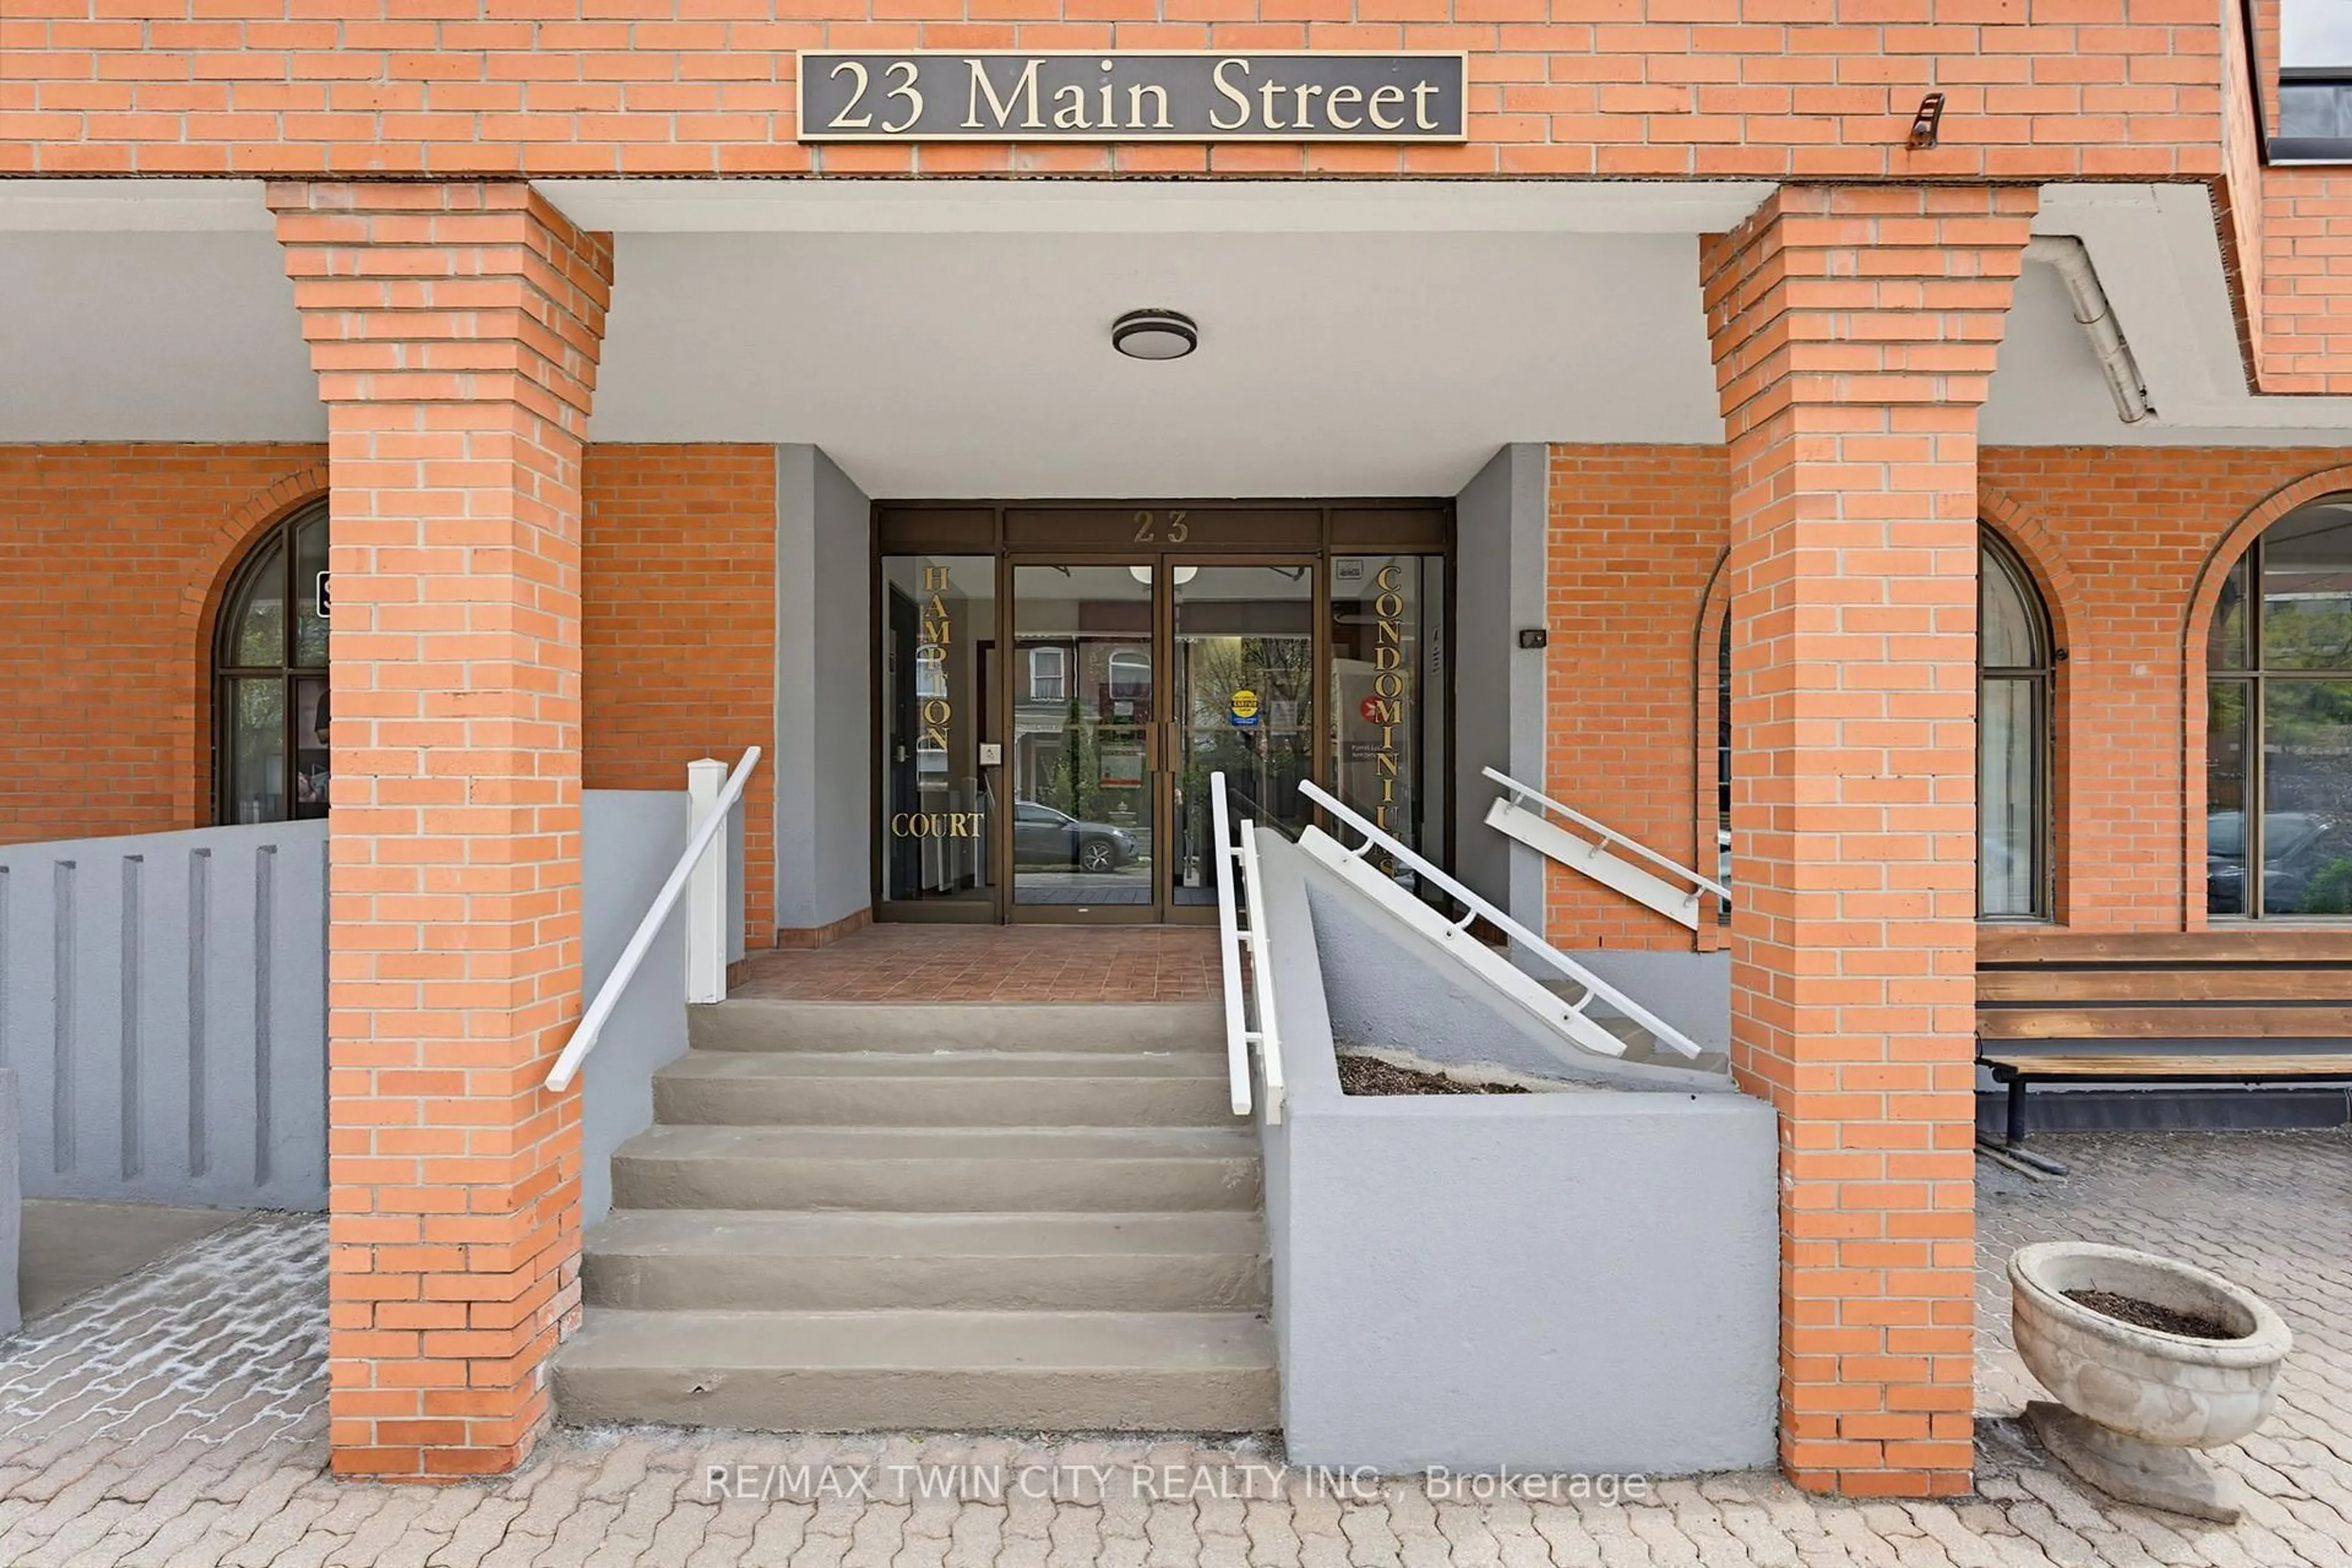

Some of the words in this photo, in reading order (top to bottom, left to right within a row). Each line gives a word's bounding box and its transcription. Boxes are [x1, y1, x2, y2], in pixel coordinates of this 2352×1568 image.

[827, 60, 924, 134] 23
[960, 59, 1174, 129] Main
[1209, 58, 1440, 130] Street
[1133, 510, 1189, 543] 23
[922, 566, 951, 753] HAMPTON
[891, 812, 985, 838] COURT
